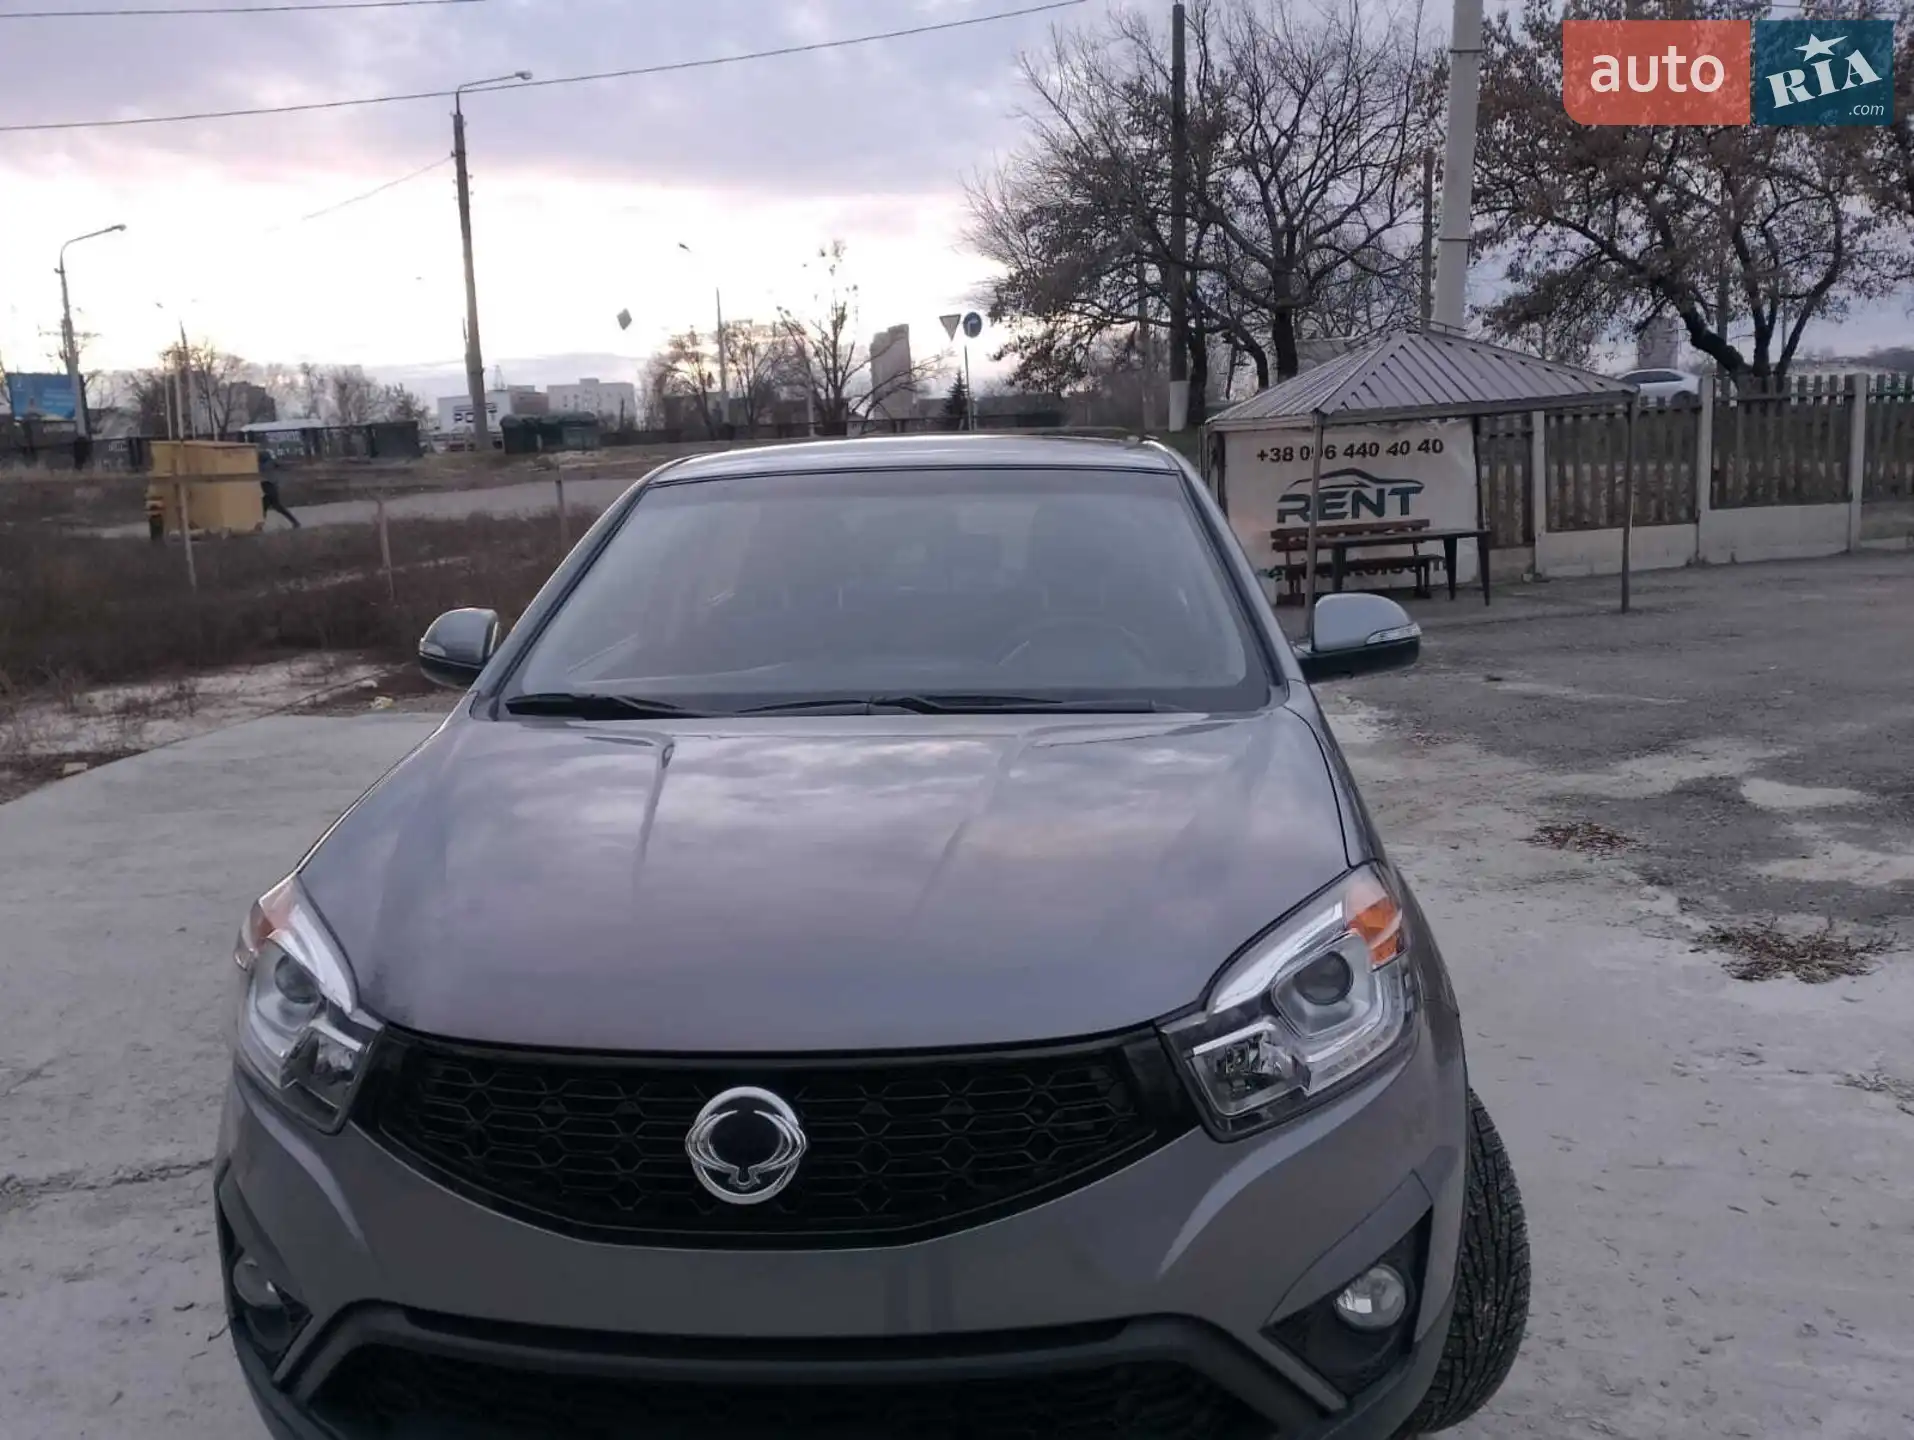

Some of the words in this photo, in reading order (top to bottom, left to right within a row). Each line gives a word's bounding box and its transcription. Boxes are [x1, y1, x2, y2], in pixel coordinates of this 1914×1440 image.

[453, 408, 498, 424] РОТ
[1257, 446, 1294, 462] +38
[1343, 442, 1380, 459] 440
[1386, 440, 1410, 456] 40
[1417, 438, 1444, 454] 40
[1277, 486, 1424, 524] RENT
